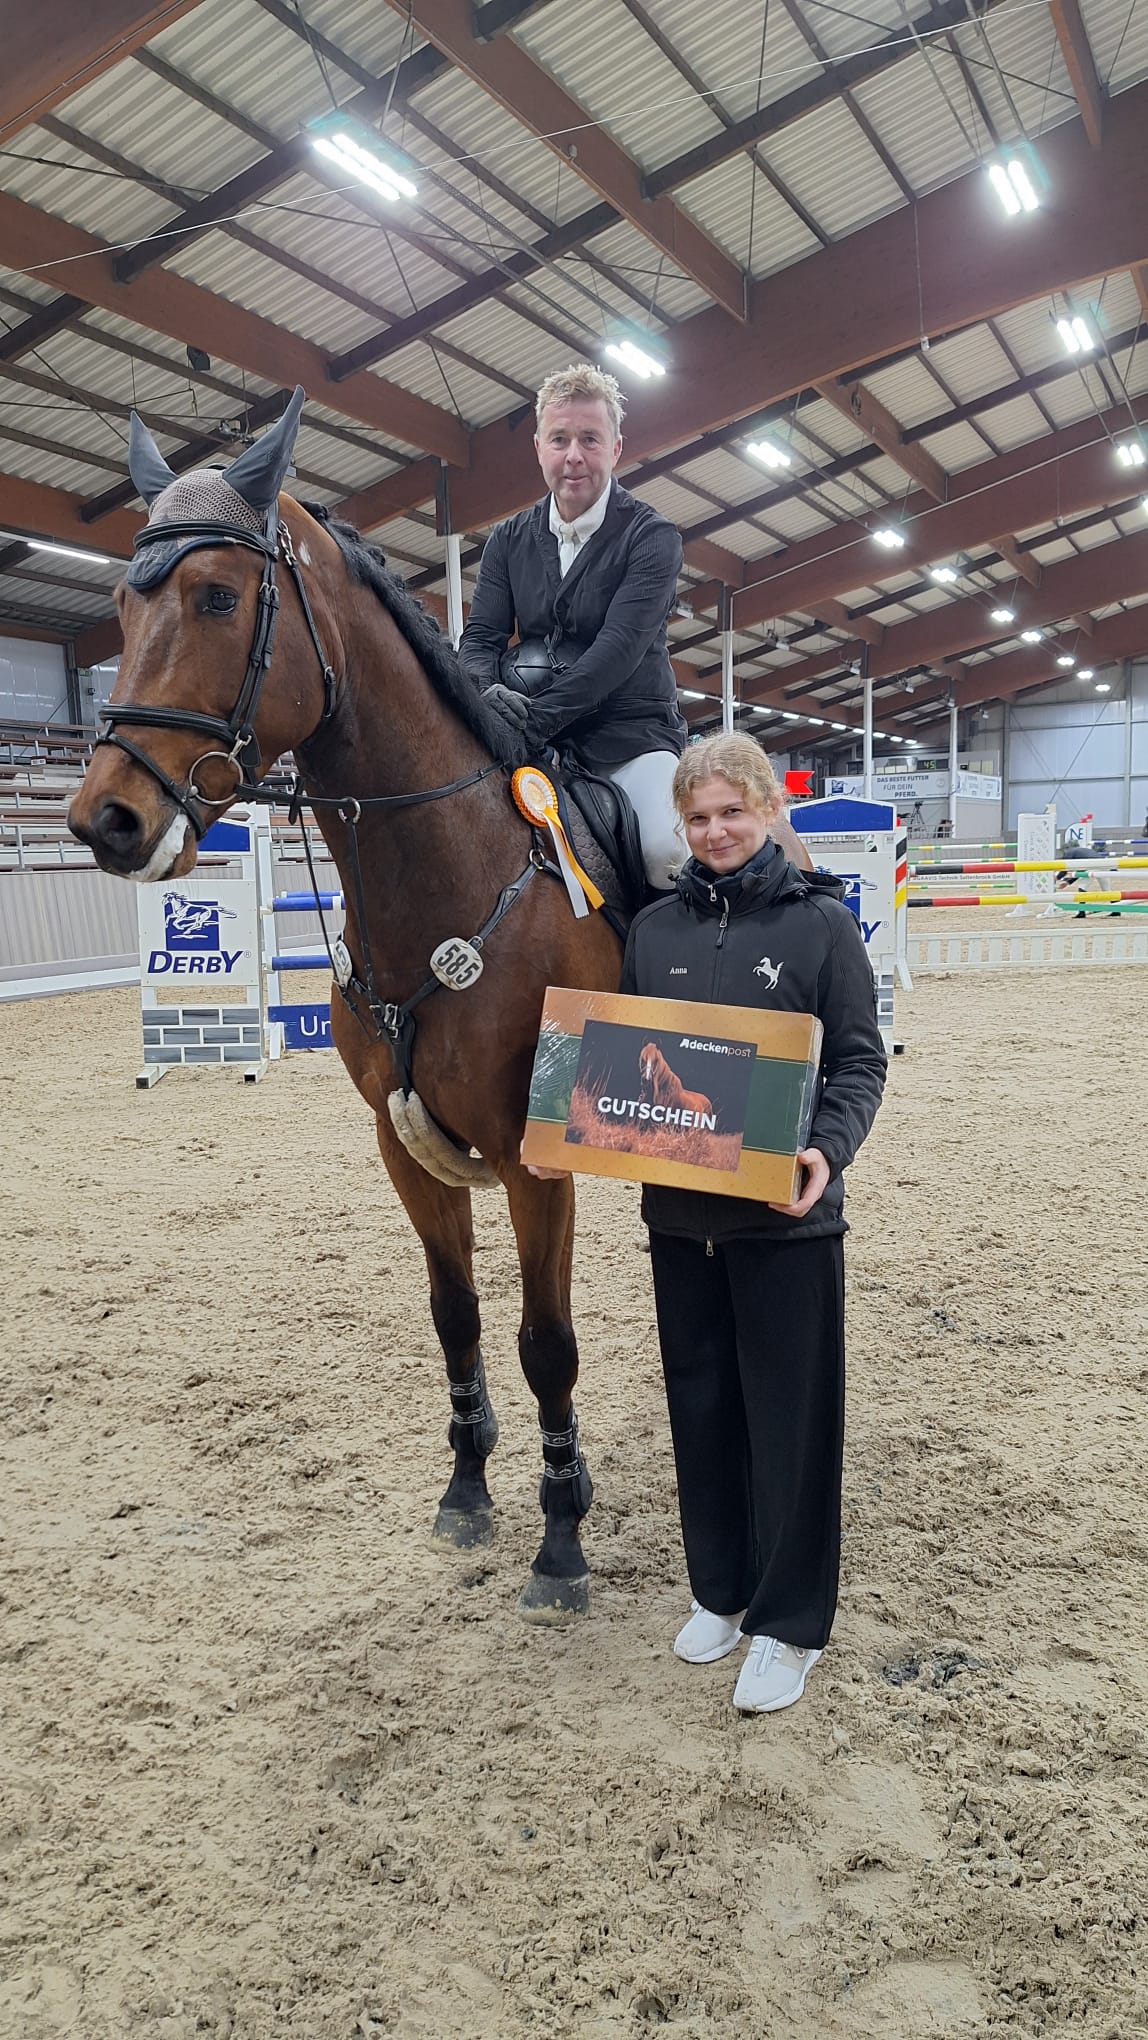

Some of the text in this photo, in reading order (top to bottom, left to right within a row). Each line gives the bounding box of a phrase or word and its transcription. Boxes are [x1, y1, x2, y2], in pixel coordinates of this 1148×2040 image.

[883, 783, 896, 791] FÜR
[436, 943, 480, 985] 585
[669, 966, 688, 975] Anna
[597, 1096, 717, 1131] GUTSCHEIN
